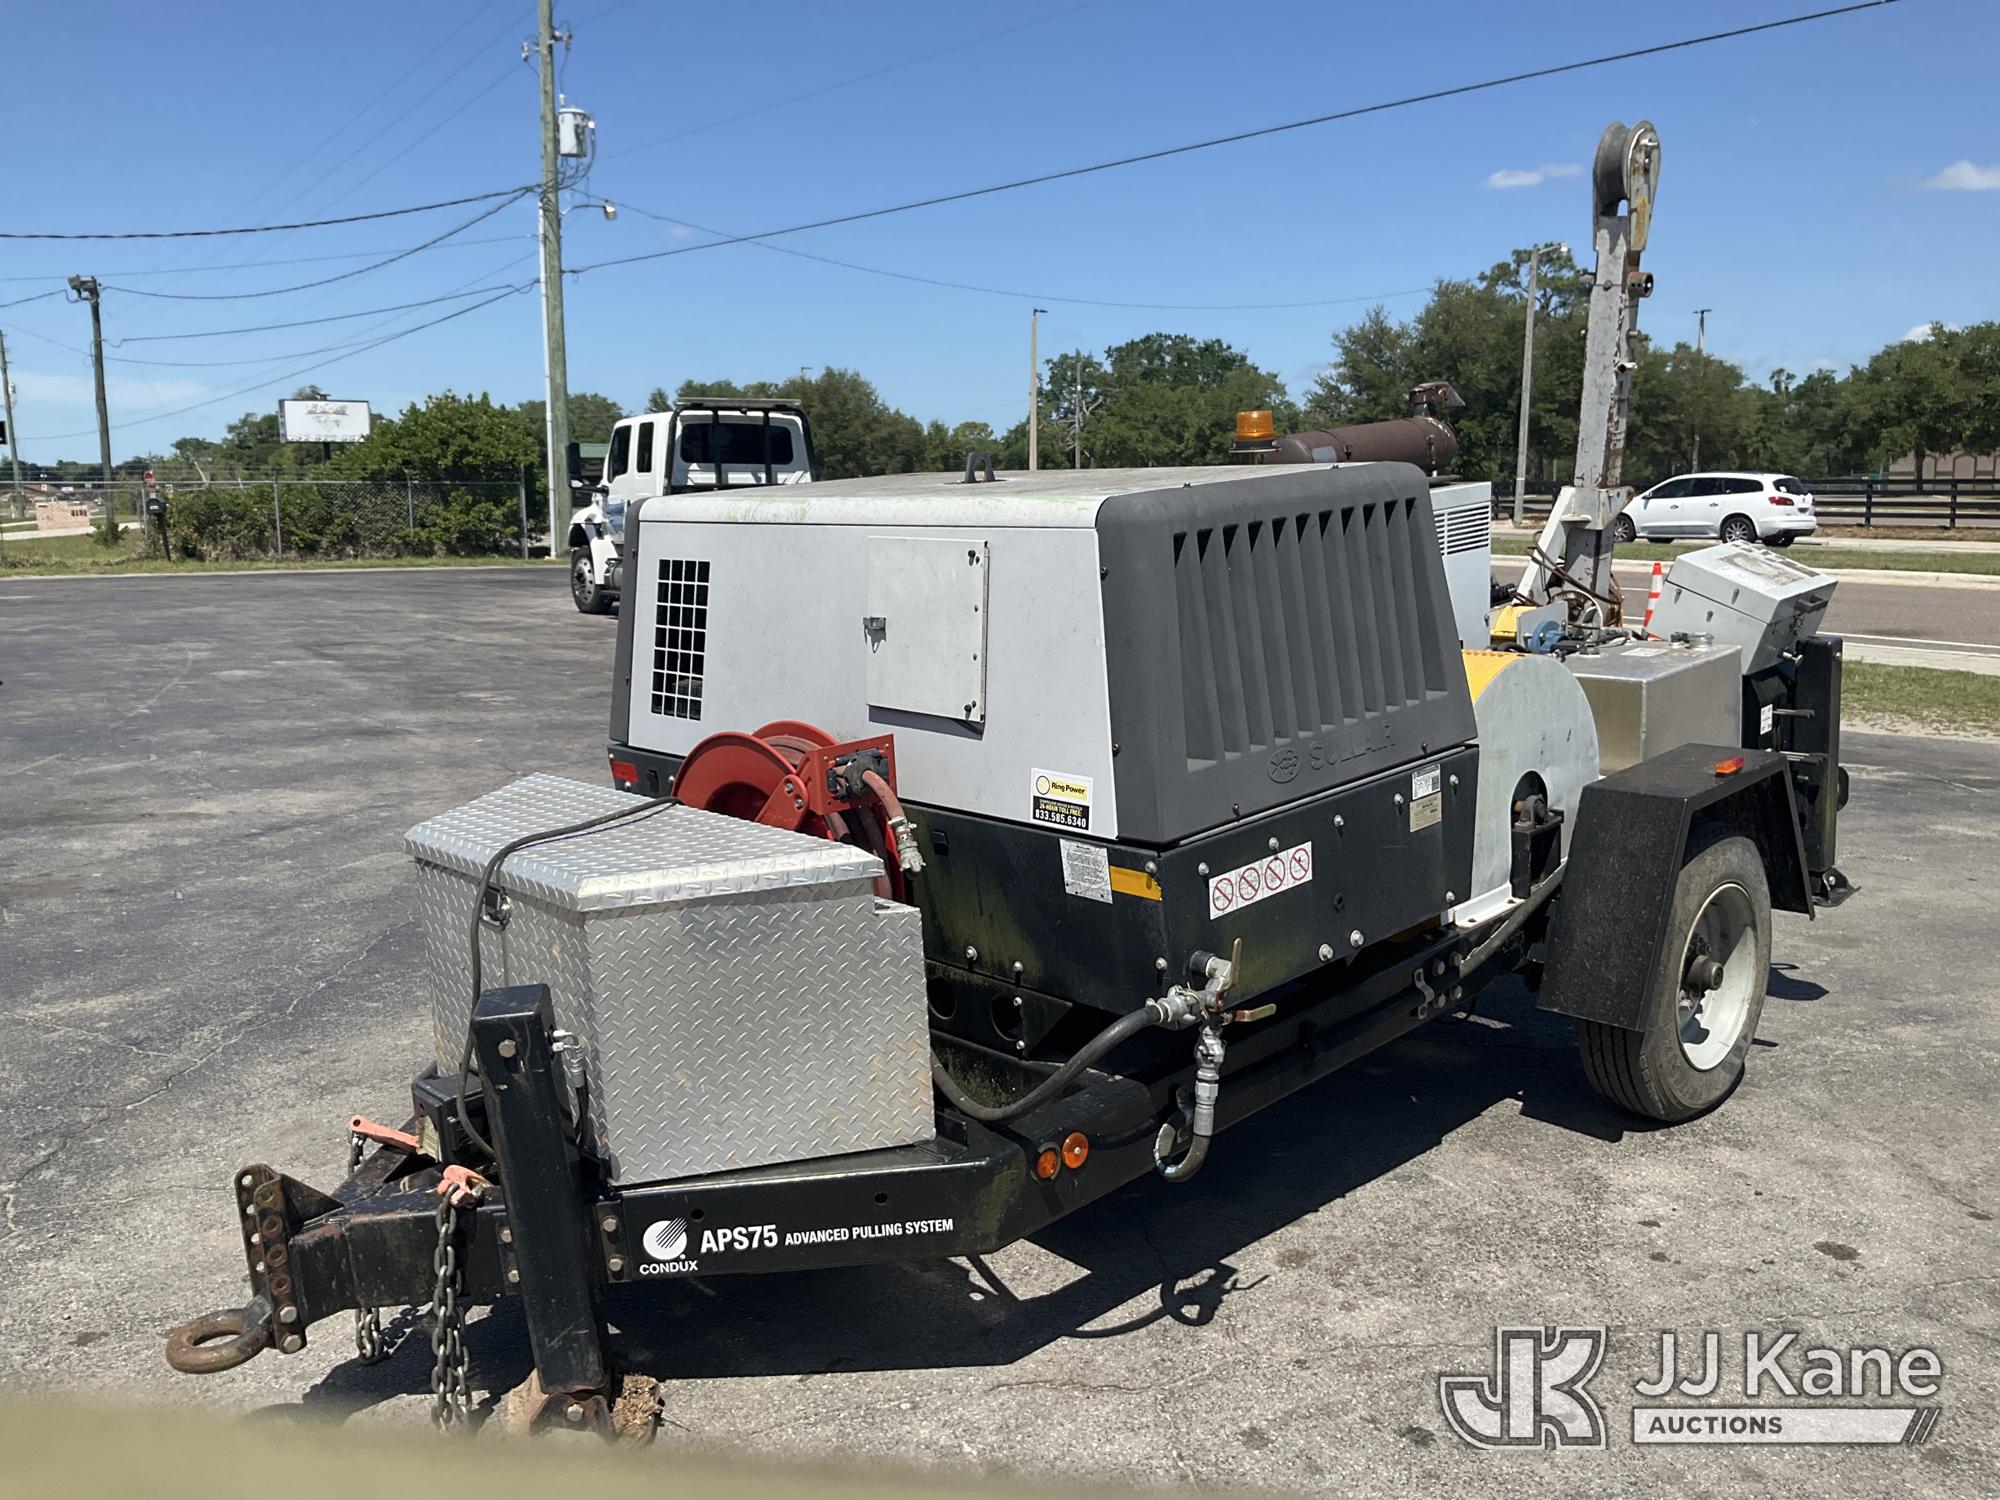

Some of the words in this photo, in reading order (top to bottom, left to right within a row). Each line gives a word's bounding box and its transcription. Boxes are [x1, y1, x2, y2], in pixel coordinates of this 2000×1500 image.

[1051, 782, 1065, 792] Ring
[1065, 785, 1085, 795] Power
[1035, 809, 1087, 828] 833.585.6340
[700, 1224, 779, 1254] APS75
[784, 1227, 850, 1246] ADVANCED
[851, 1222, 903, 1240] PULLING
[905, 1218, 954, 1235] SYSTEM
[639, 1260, 699, 1275] CONDUX
